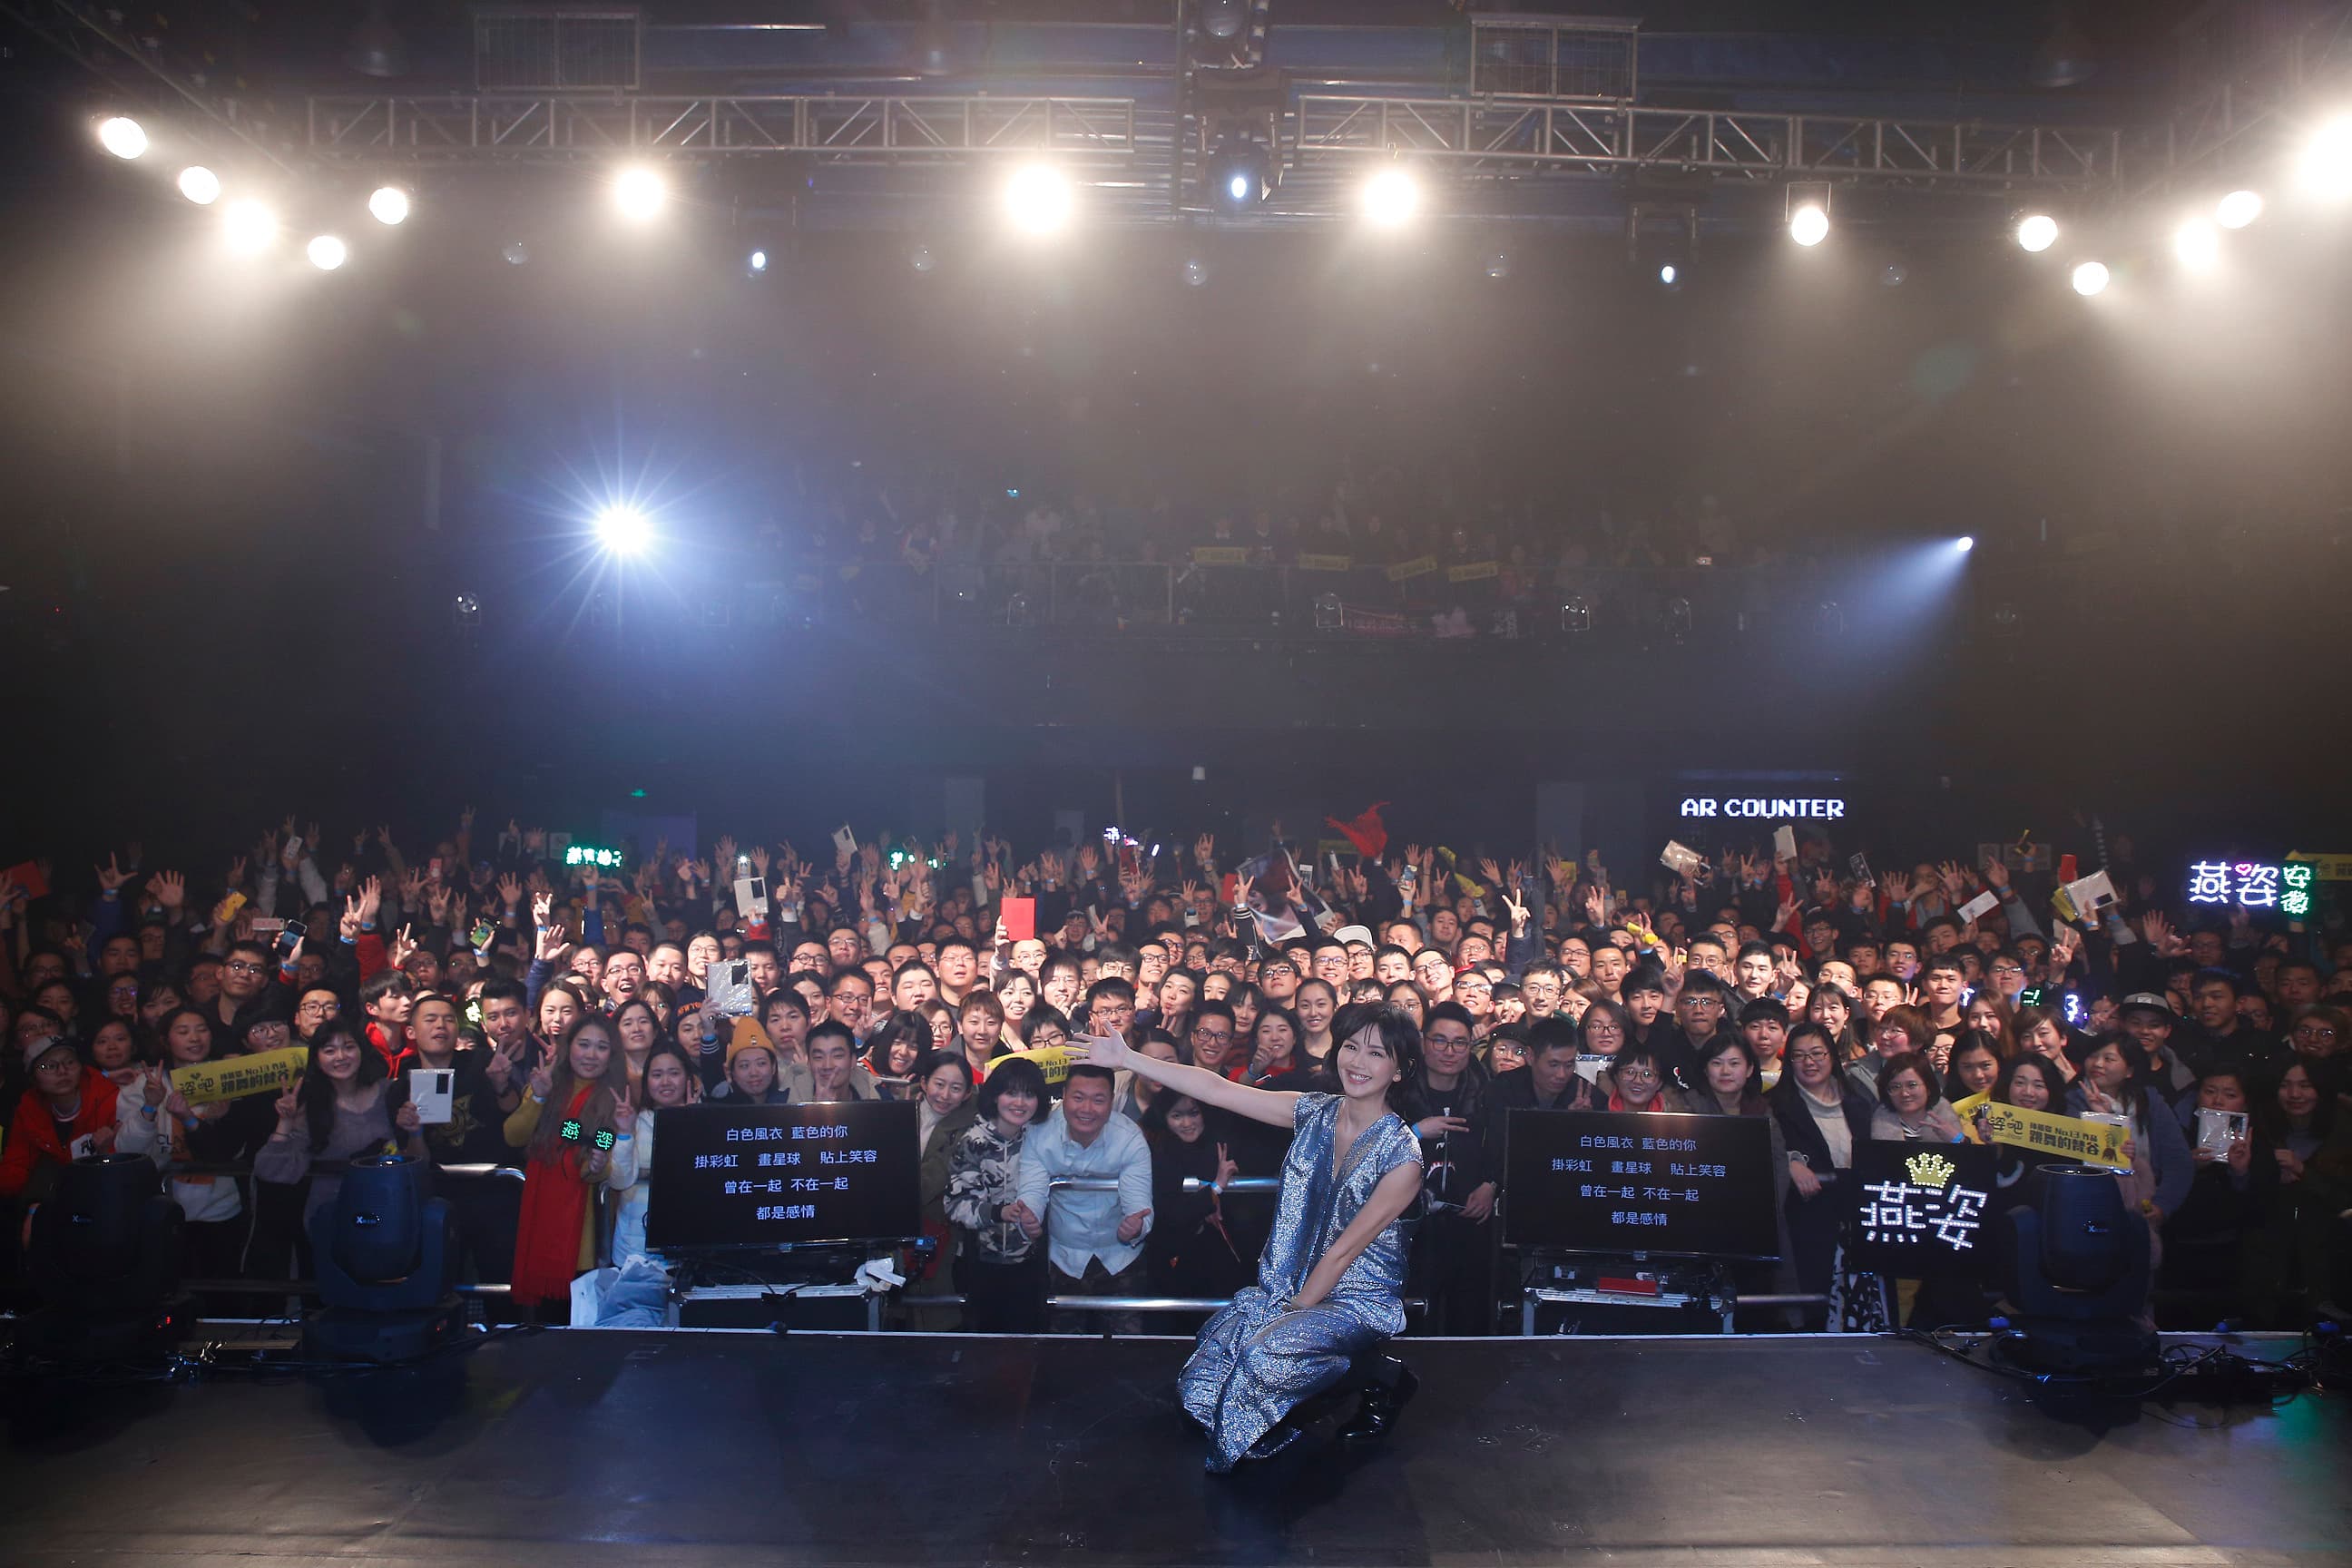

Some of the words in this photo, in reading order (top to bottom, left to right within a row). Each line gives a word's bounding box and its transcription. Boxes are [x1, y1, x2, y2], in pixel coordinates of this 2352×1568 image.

[1681, 798, 1717, 817] AR
[1724, 799, 1845, 818] COUNTER
[2189, 860, 2278, 906] 燕姿
[726, 1127, 783, 1142] 白色風衣
[791, 1124, 848, 1140] 藍色的你
[1580, 1135, 1633, 1149] 白色風衣
[1642, 1137, 1697, 1152] 藍色的你
[694, 1154, 739, 1169] 掛彩虹
[758, 1152, 800, 1167] 畫星球
[819, 1150, 877, 1164] 貼上笑容
[1551, 1158, 1592, 1172] 掛彩虹
[1611, 1161, 1652, 1174] 畫星球
[1670, 1163, 1727, 1177] 貼上笑容
[724, 1179, 782, 1194] 曾在一起
[790, 1176, 848, 1191] 不在一起
[1580, 1184, 1635, 1199] 曾在一起
[1642, 1187, 1700, 1201] 不在一起
[756, 1204, 816, 1220] 都是感情
[1611, 1211, 1668, 1226] 都是感情
[1859, 1180, 1987, 1250] 燕姿
